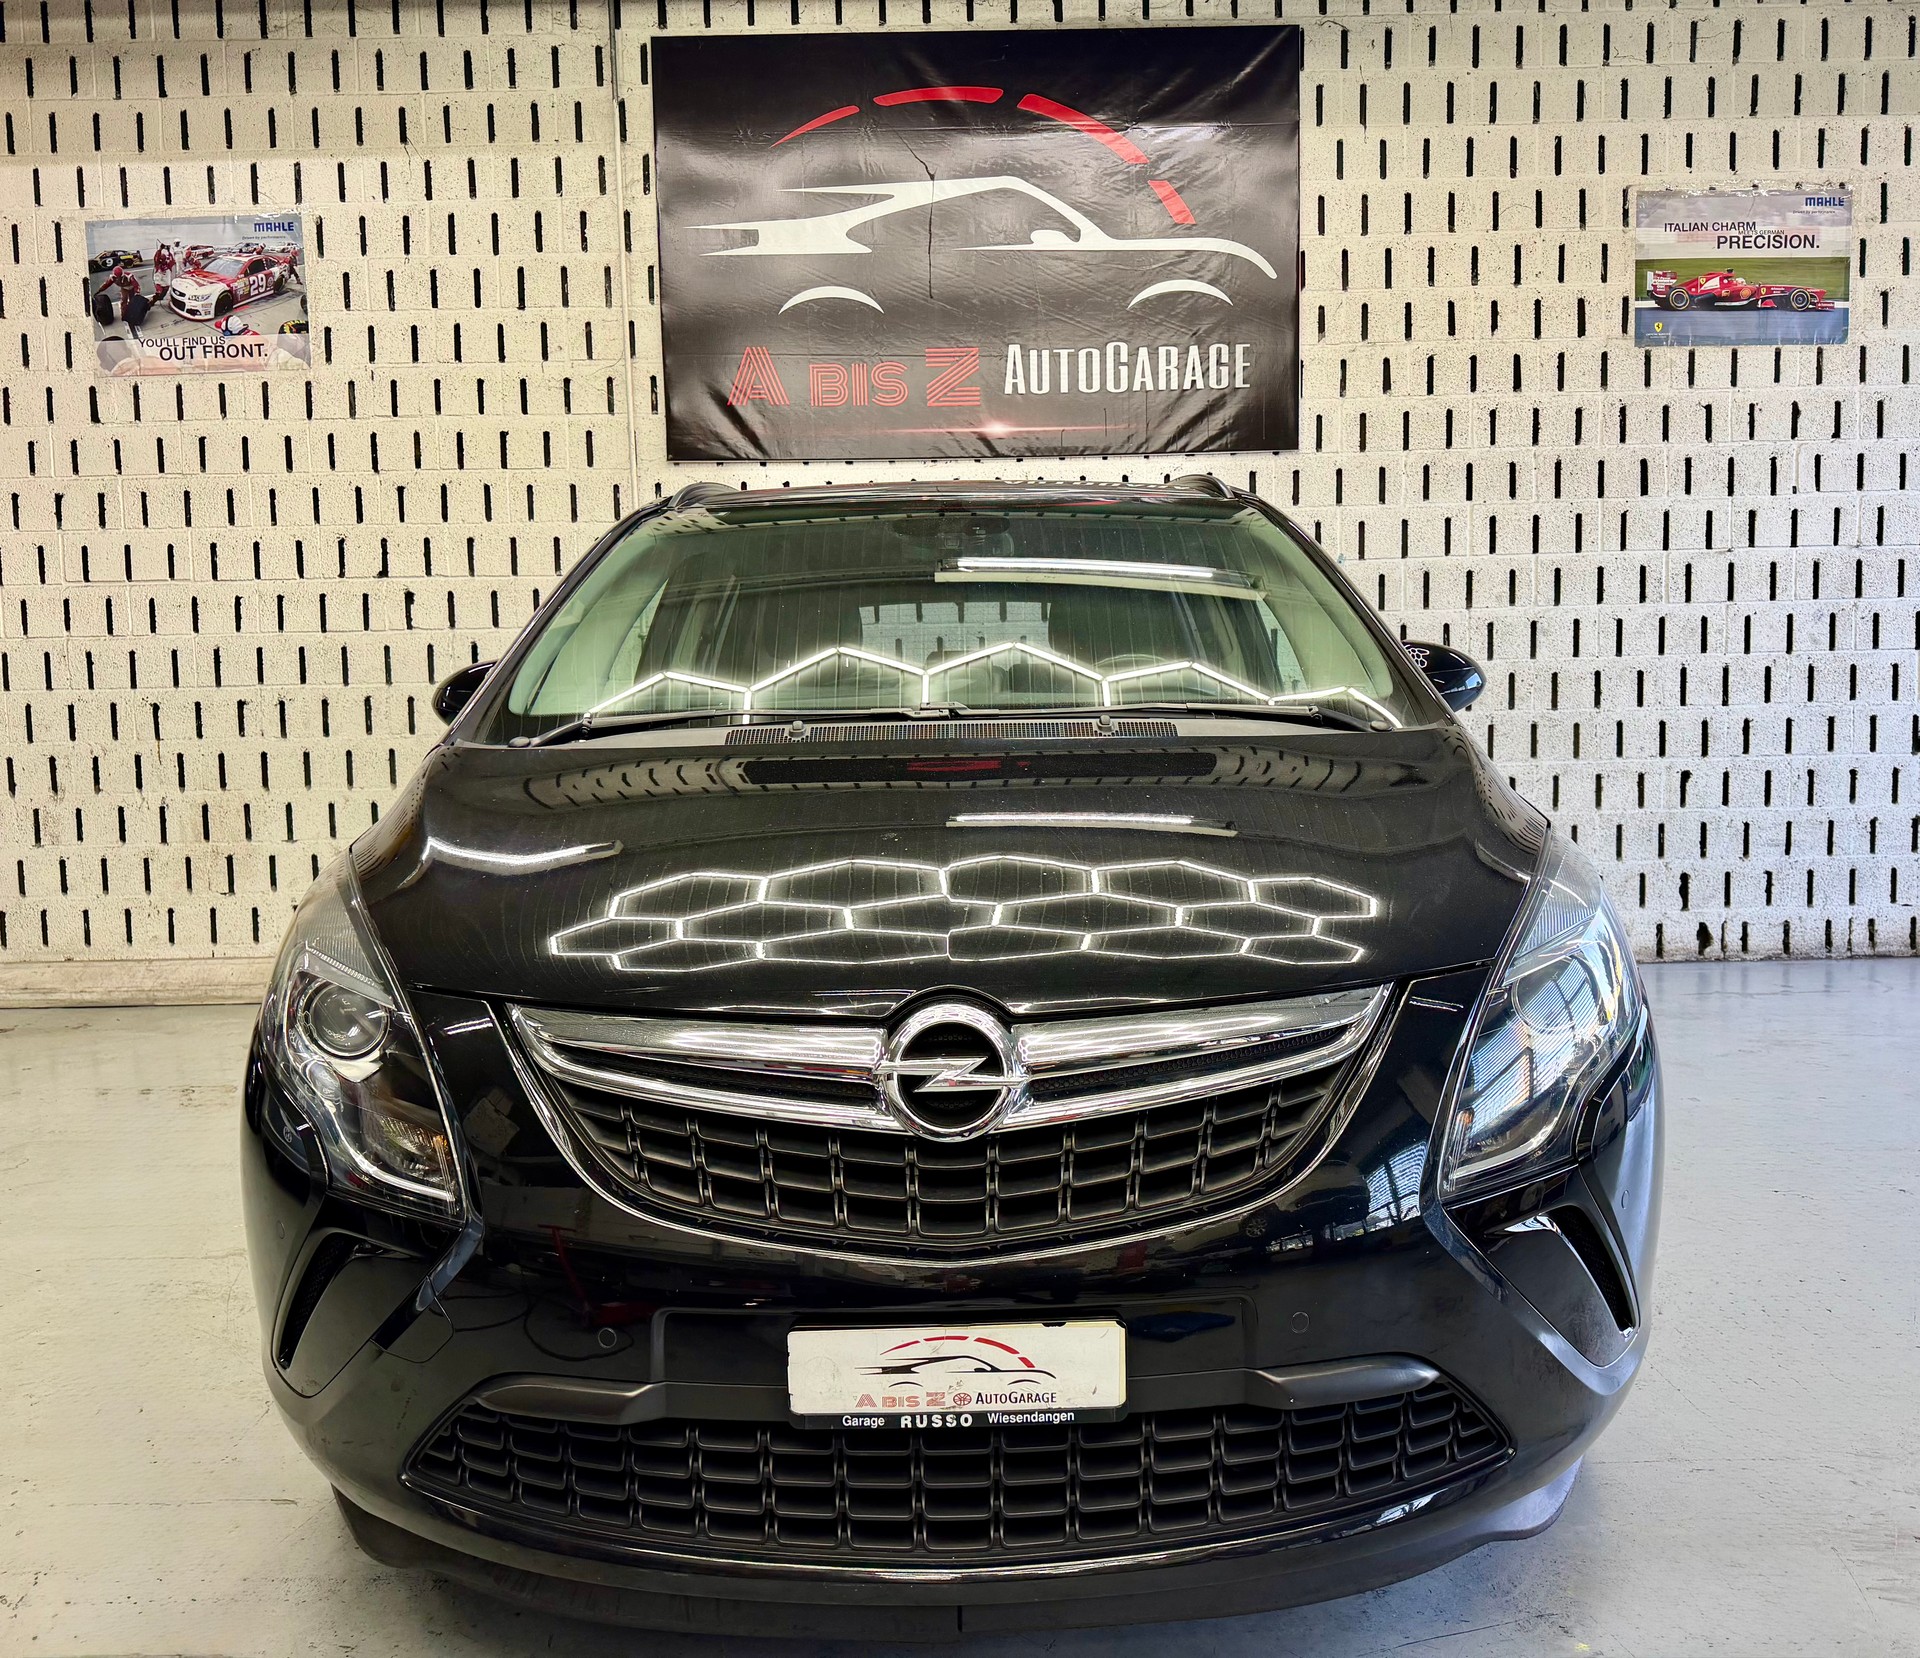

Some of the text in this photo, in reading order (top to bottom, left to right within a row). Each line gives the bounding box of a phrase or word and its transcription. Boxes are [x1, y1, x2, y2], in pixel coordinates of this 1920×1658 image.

[1805, 196, 1845, 207] MAHLE
[254, 221, 295, 232] MAHLE
[1664, 221, 1756, 232] ITALIAN CHARM
[1717, 234, 1820, 249] PRECISION.
[249, 273, 266, 296] 29
[139, 335, 226, 348] YOU'LL FIND US
[160, 343, 268, 361] OUT FRONT.
[727, 346, 790, 406] A
[925, 347, 981, 407] Z
[855, 1393, 878, 1408] A
[925, 1391, 945, 1407] Z
[842, 1411, 1075, 1429] Garage RUSSO Wiesendangen
